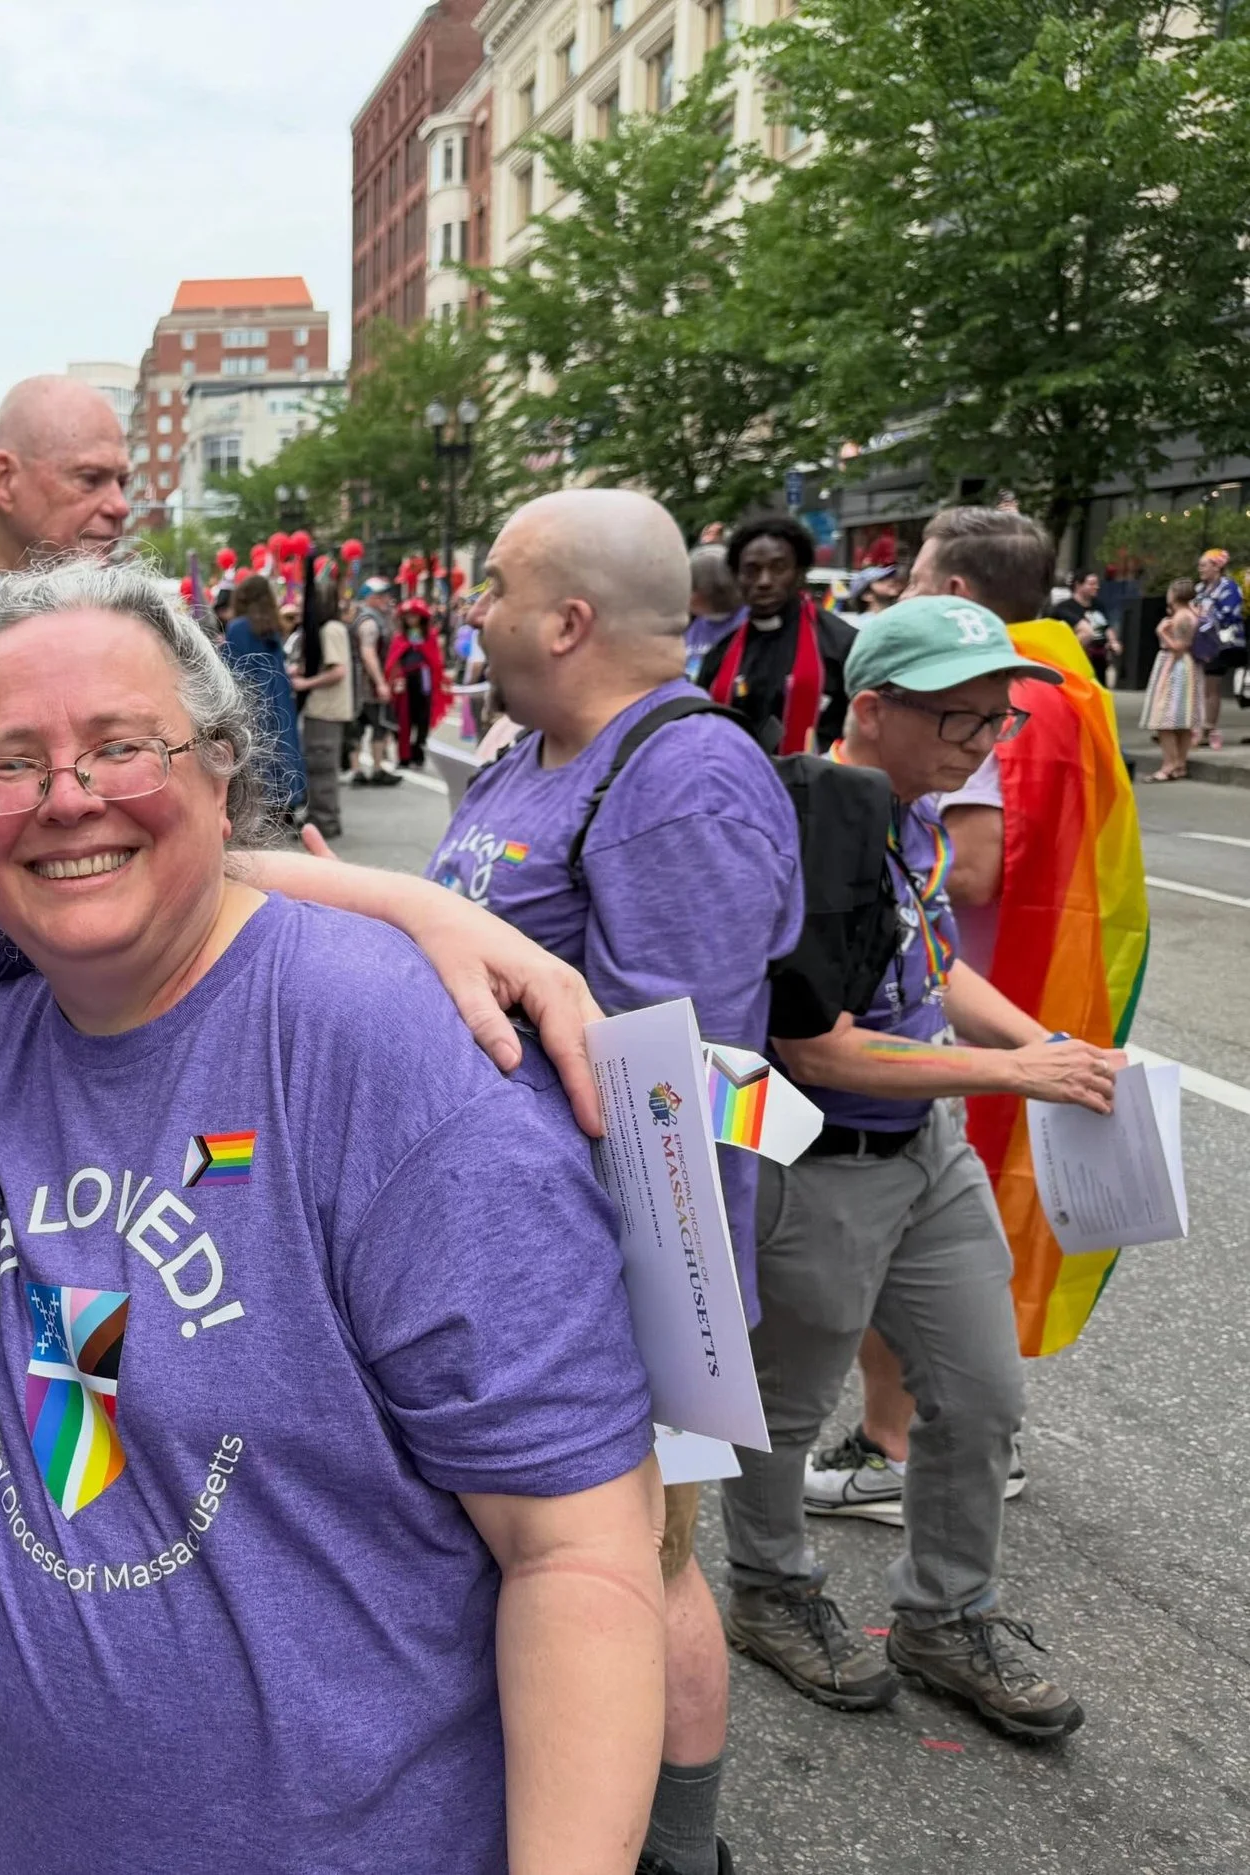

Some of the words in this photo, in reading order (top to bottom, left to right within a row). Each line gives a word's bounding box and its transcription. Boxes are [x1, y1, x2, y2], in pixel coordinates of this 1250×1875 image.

[620, 1056, 635, 1110] WELCOME
[26, 1166, 246, 1339] LOVED!
[660, 1134, 720, 1378] MASSACHUSETTS
[673, 1133, 693, 1203] EPISCOPAL
[688, 1206, 705, 1265] DIOCESE
[700, 1266, 711, 1286] OF
